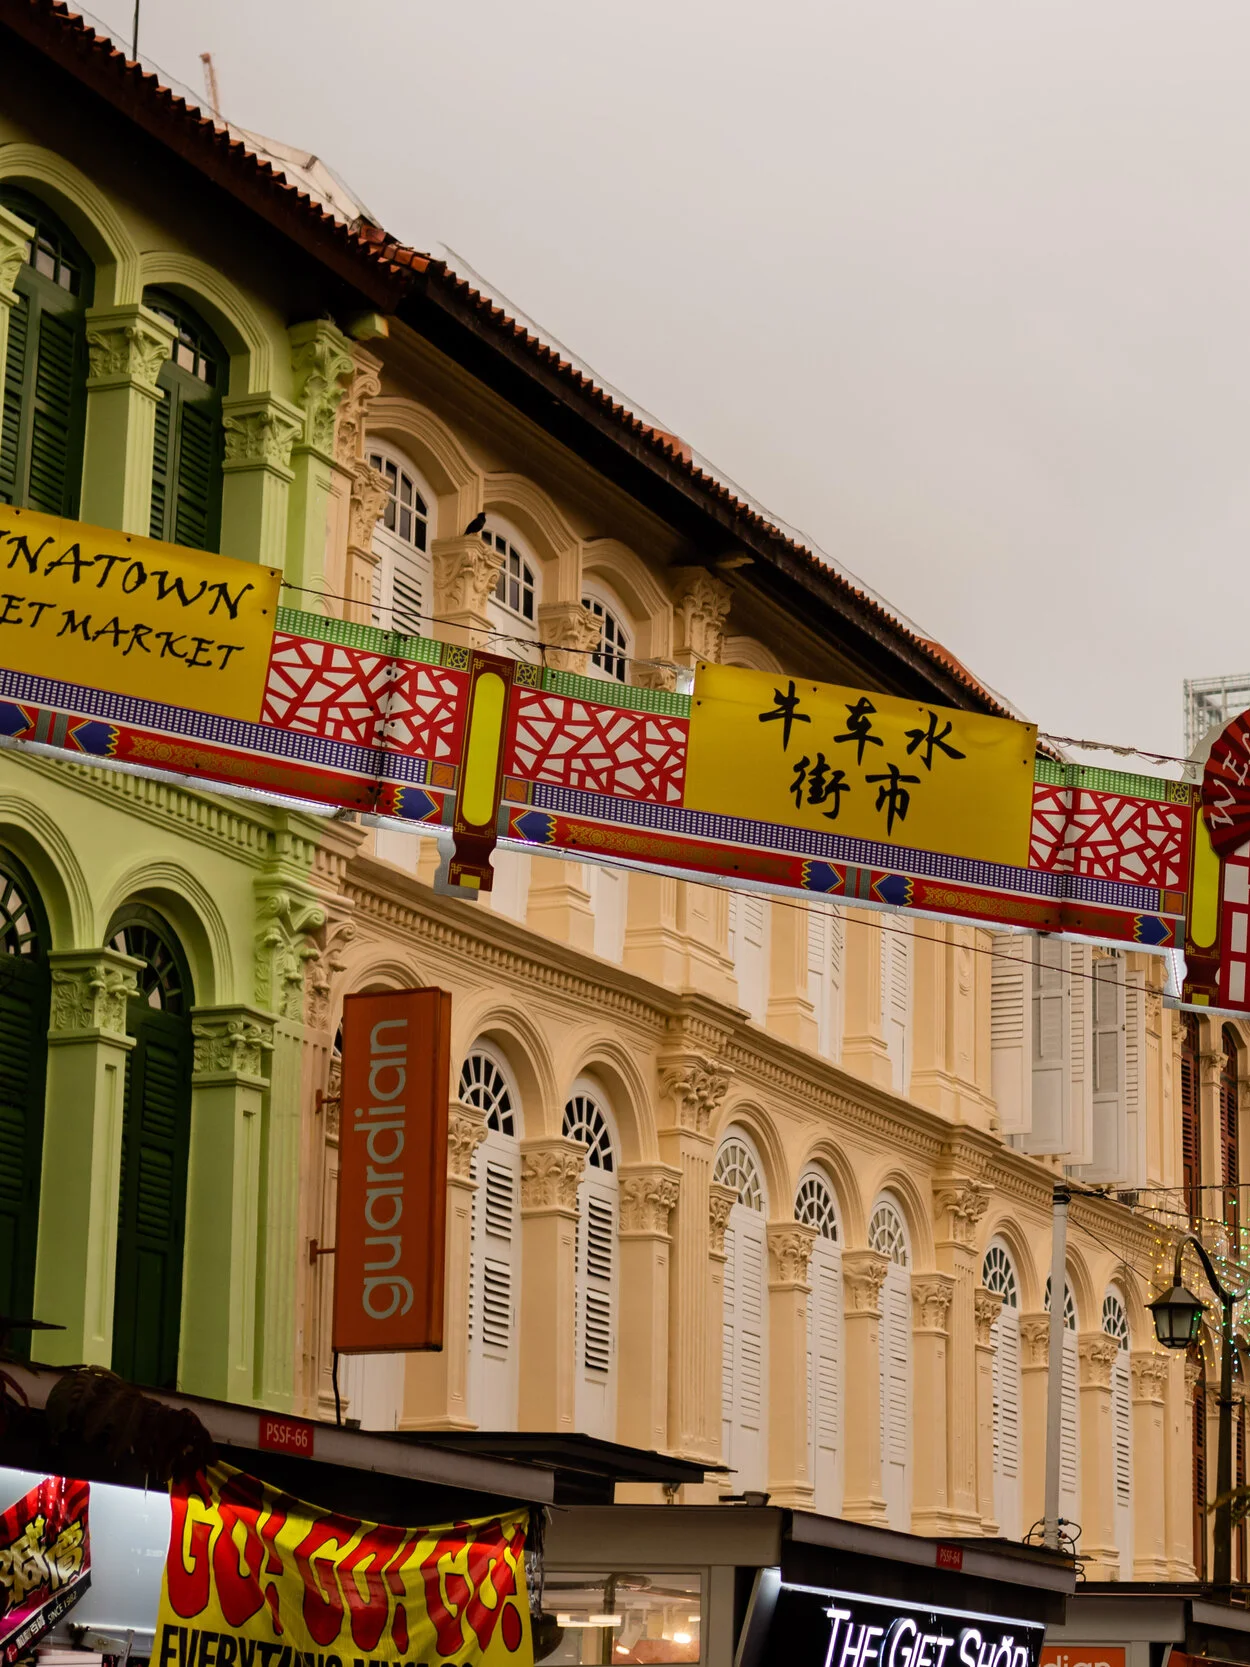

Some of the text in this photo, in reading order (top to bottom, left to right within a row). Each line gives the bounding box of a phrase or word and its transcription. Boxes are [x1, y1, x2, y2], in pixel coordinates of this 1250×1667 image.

[0, 529, 254, 620] NATOWN
[56, 608, 245, 671] MARKET
[759, 680, 966, 771] 牛车水
[789, 752, 921, 837] 街市
[354, 1018, 415, 1321] guardian
[266, 1422, 308, 1448] PSSF-66
[824, 1608, 884, 1667] THE
[885, 1618, 955, 1667] GIFT
